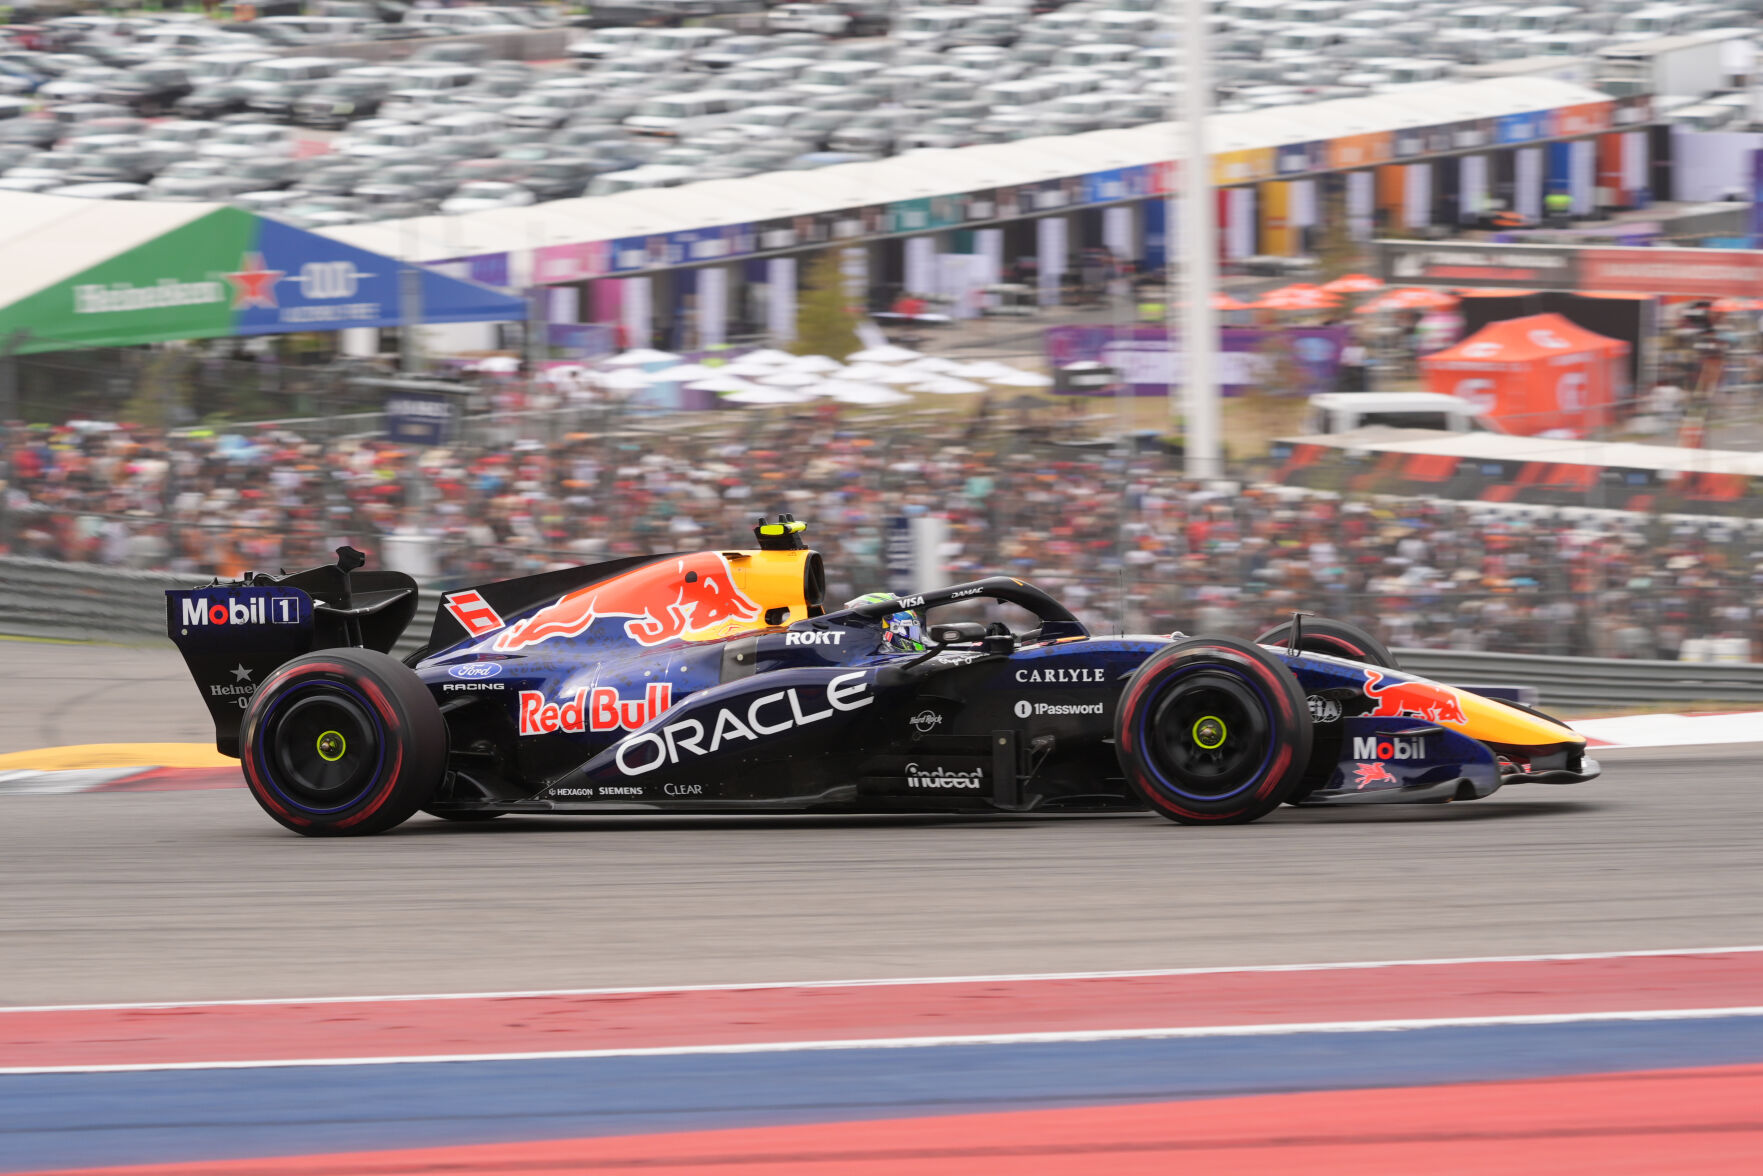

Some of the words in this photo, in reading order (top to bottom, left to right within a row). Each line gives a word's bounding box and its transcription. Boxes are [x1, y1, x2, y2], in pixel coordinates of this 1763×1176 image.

[951, 587, 984, 599] DAMAC
[897, 596, 925, 609] VISA
[182, 597, 266, 626] Mobil
[785, 631, 845, 646] ROKT
[457, 663, 493, 677] Ford
[1015, 668, 1105, 682] CARLYLE
[210, 684, 260, 696] Heine
[442, 683, 505, 692] RACING
[519, 686, 590, 736] Red
[590, 682, 672, 732] Bull
[1034, 703, 1103, 715] 1Password
[615, 670, 875, 776] ORACLE
[925, 714, 943, 725] Rock
[1352, 736, 1426, 760] Mobil
[905, 762, 984, 789] indeed
[557, 788, 593, 796] HEXAGON
[599, 787, 643, 795] SIEMENS
[663, 783, 703, 795] CLEAR
